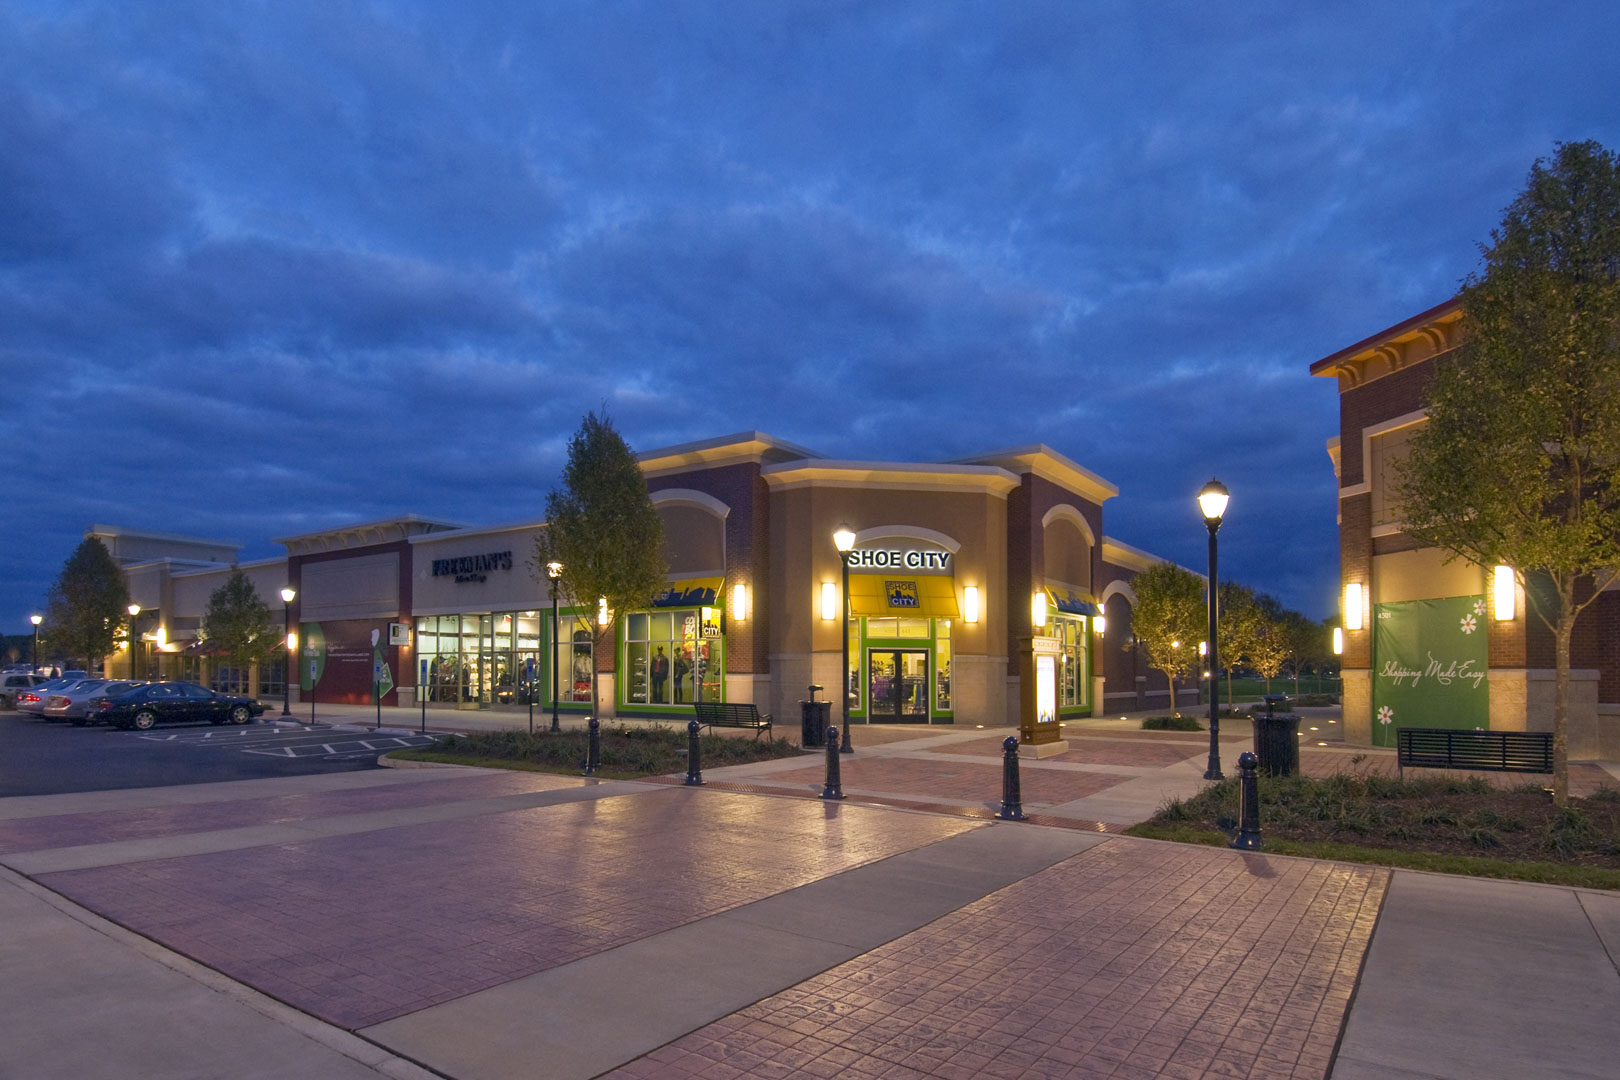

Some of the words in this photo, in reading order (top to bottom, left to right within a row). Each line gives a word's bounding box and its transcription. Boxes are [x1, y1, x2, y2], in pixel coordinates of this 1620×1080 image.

[848, 549, 901, 568] SHOE
[905, 550, 950, 569] CITY
[889, 583, 914, 591] SHOE
[892, 597, 915, 606] CITY
[704, 627, 719, 636] CITY
[1379, 661, 1422, 688] Shopping
[1424, 651, 1457, 685] Made
[1457, 659, 1486, 689] Easy
